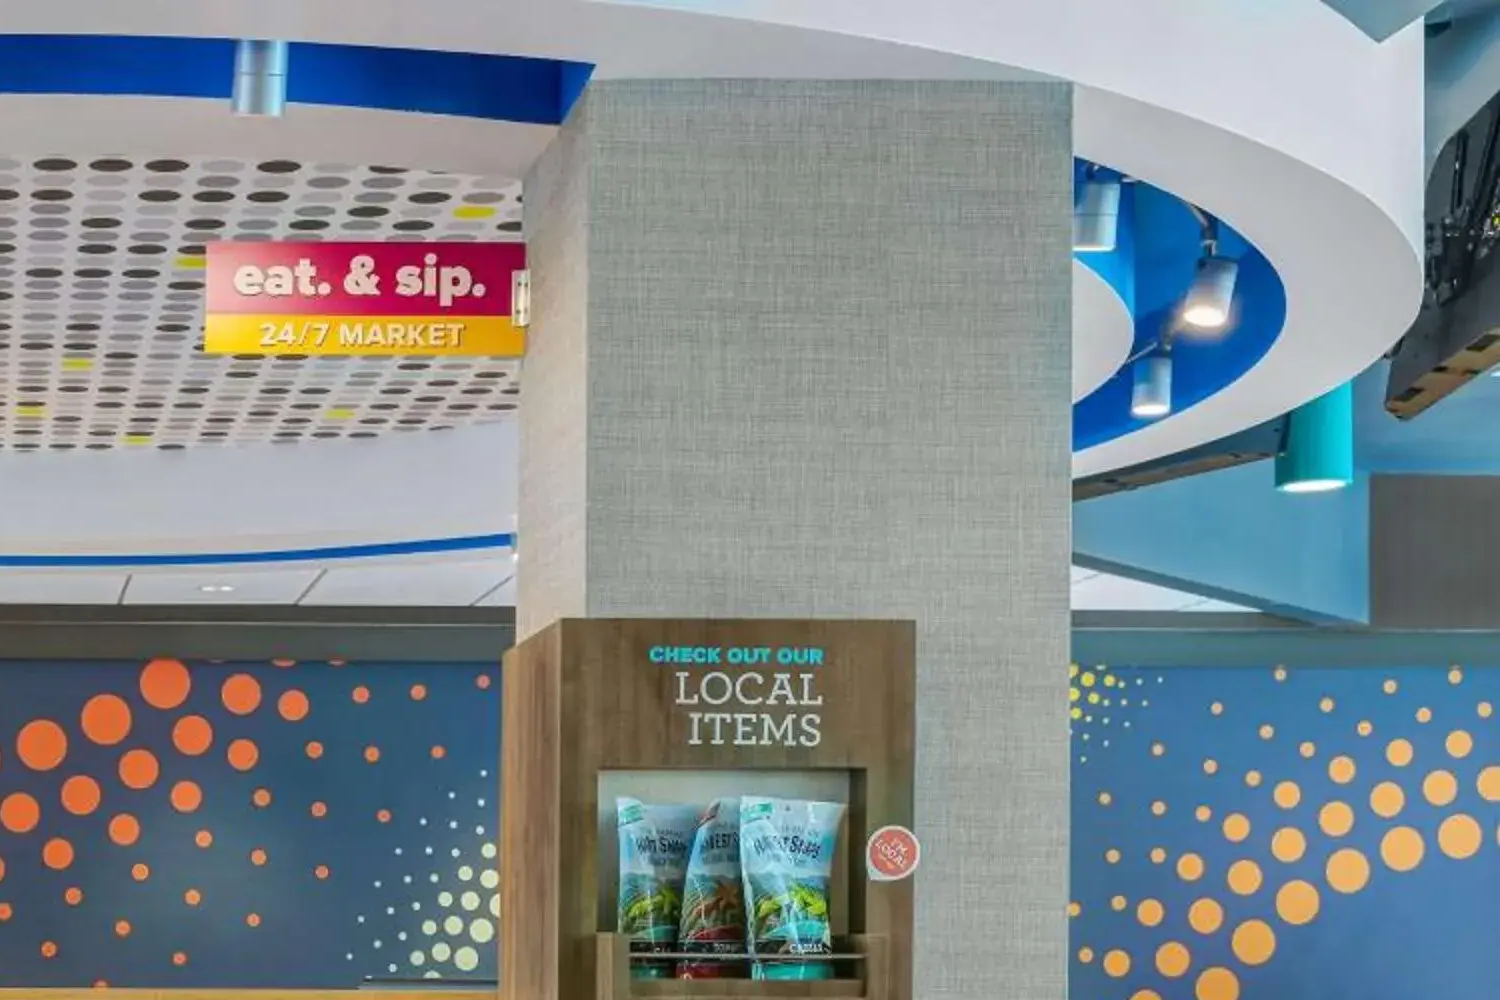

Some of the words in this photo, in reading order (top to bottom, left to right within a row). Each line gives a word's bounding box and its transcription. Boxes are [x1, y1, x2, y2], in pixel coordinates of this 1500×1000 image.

[233, 258, 332, 297] eat.
[343, 254, 382, 296] &
[395, 252, 487, 307] sip.
[259, 322, 330, 348] 24/7
[338, 322, 465, 347] MARKET
[649, 645, 722, 664] CHECK
[727, 647, 772, 664] OUT
[777, 647, 825, 665] OUR
[675, 671, 824, 706] LOCAL
[688, 712, 822, 747] ITEMS
